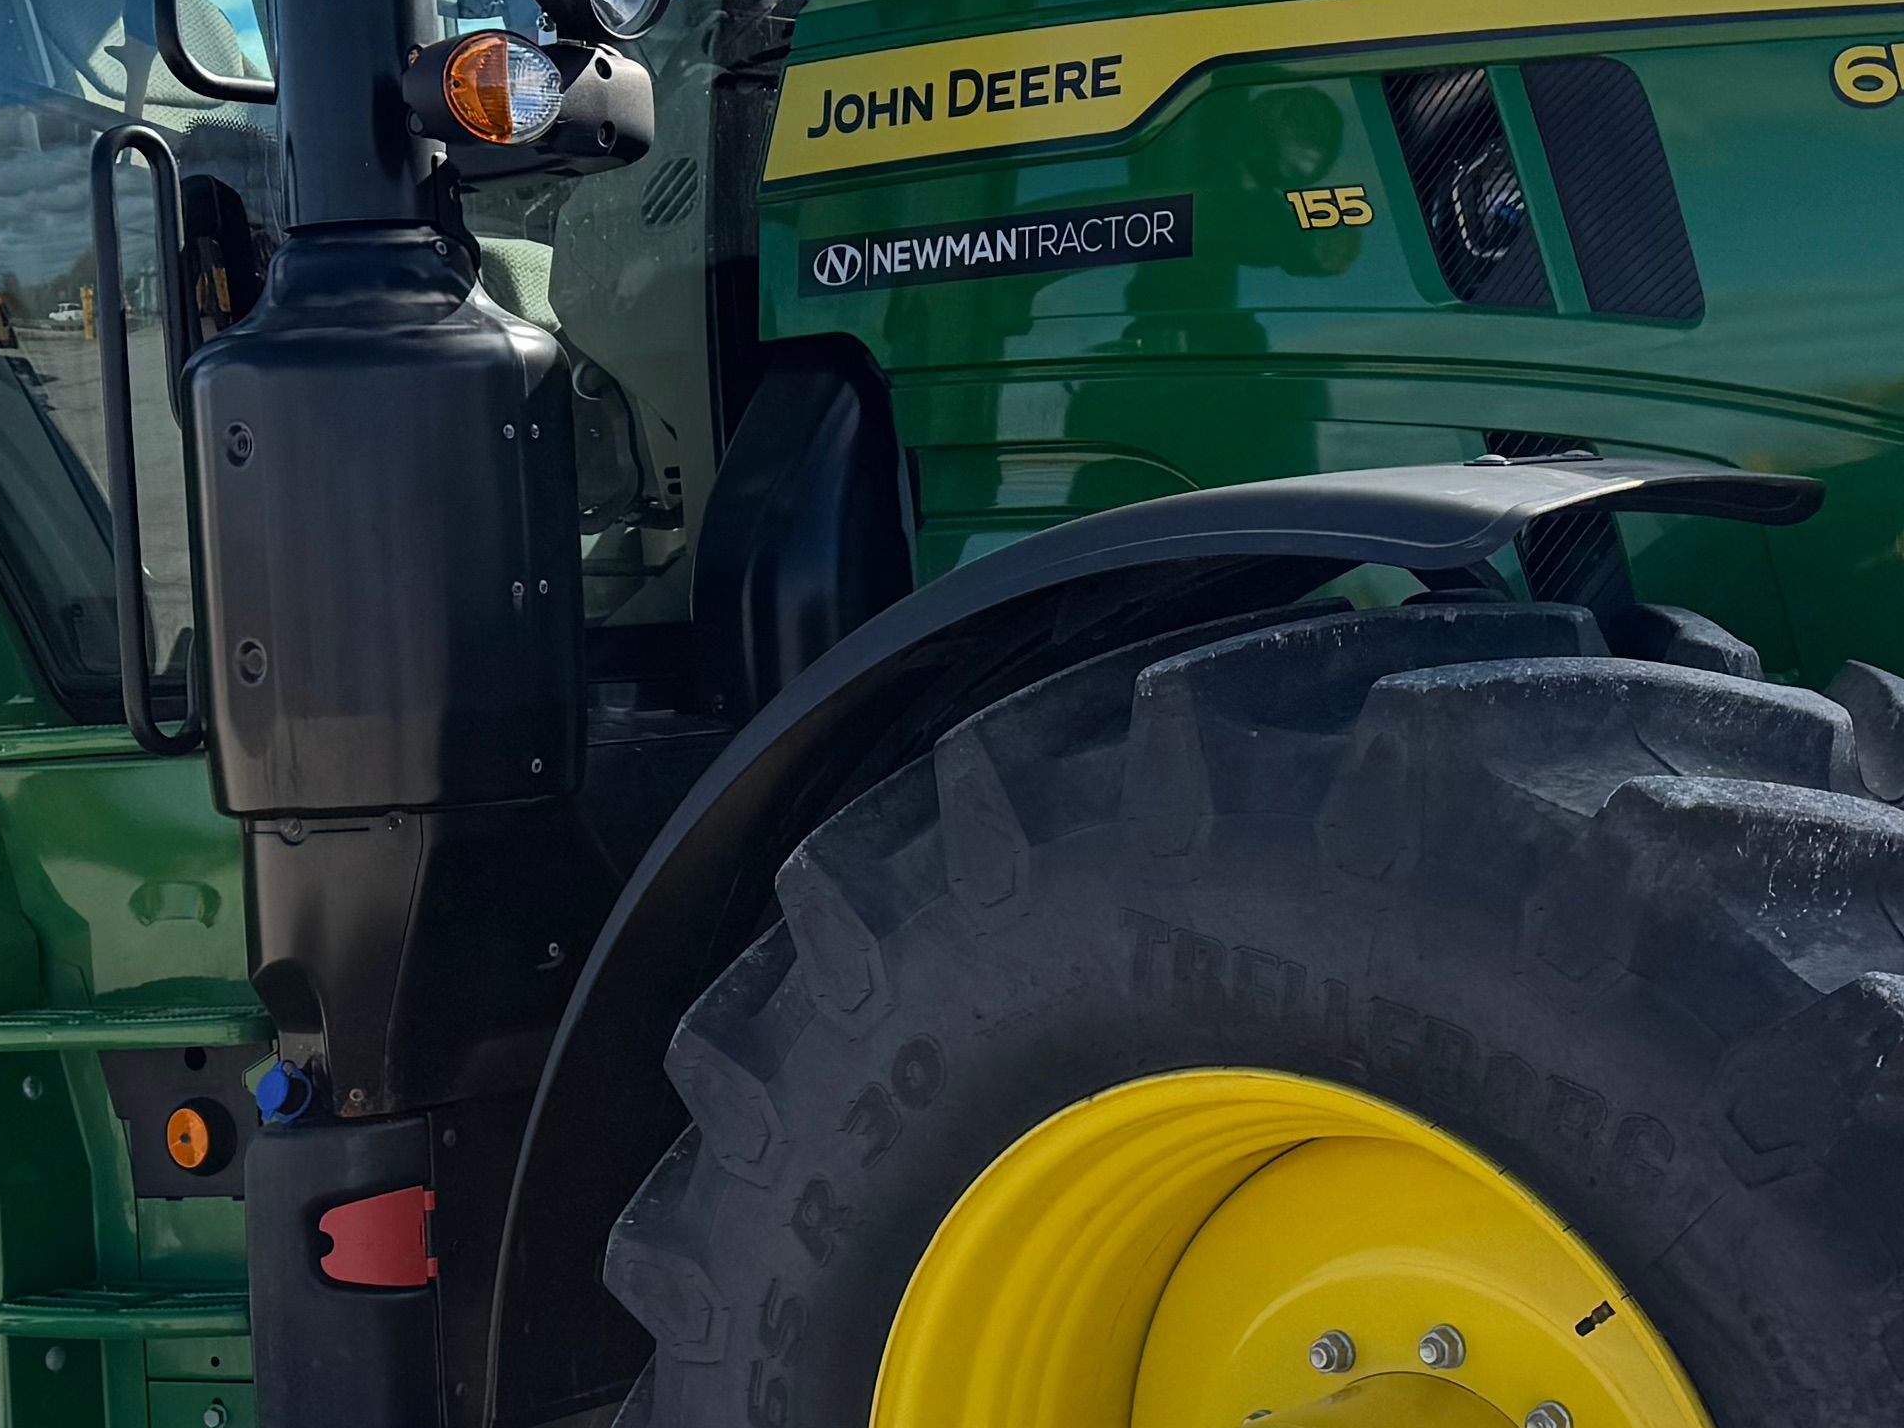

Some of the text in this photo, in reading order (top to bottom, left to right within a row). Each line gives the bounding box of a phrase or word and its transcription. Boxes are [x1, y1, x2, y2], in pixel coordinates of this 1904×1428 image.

[807, 54, 1123, 139] JOHN DEERE
[1285, 186, 1374, 229] 155
